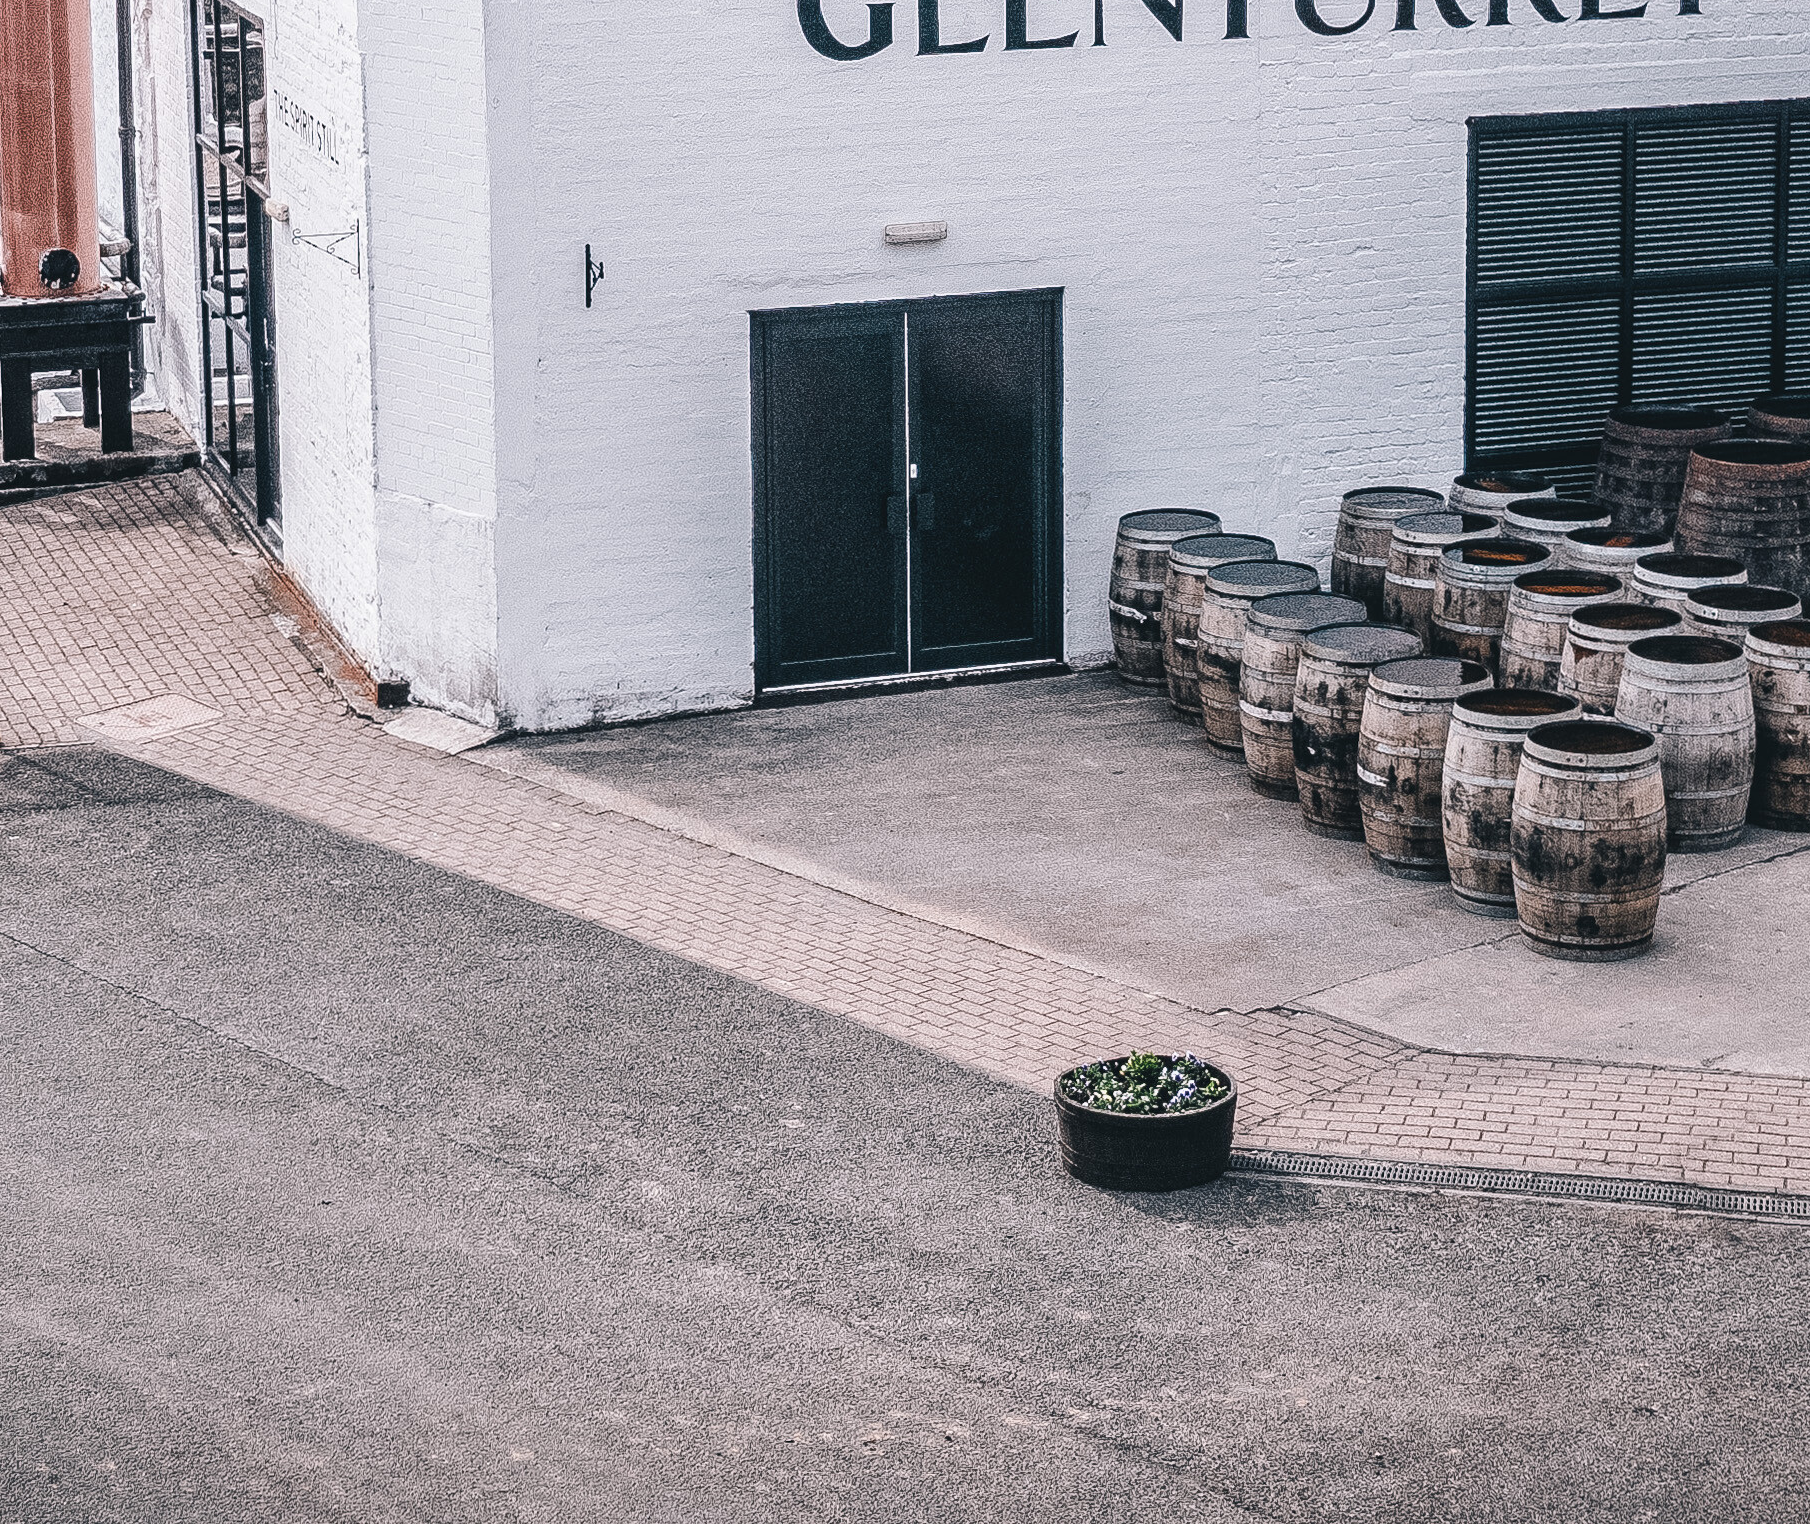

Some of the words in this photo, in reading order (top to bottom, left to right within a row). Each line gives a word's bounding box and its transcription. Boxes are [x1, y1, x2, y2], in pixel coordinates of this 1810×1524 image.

[273, 88, 290, 128] THE
[289, 101, 315, 147] SPIRIT
[316, 119, 340, 166] STILL
